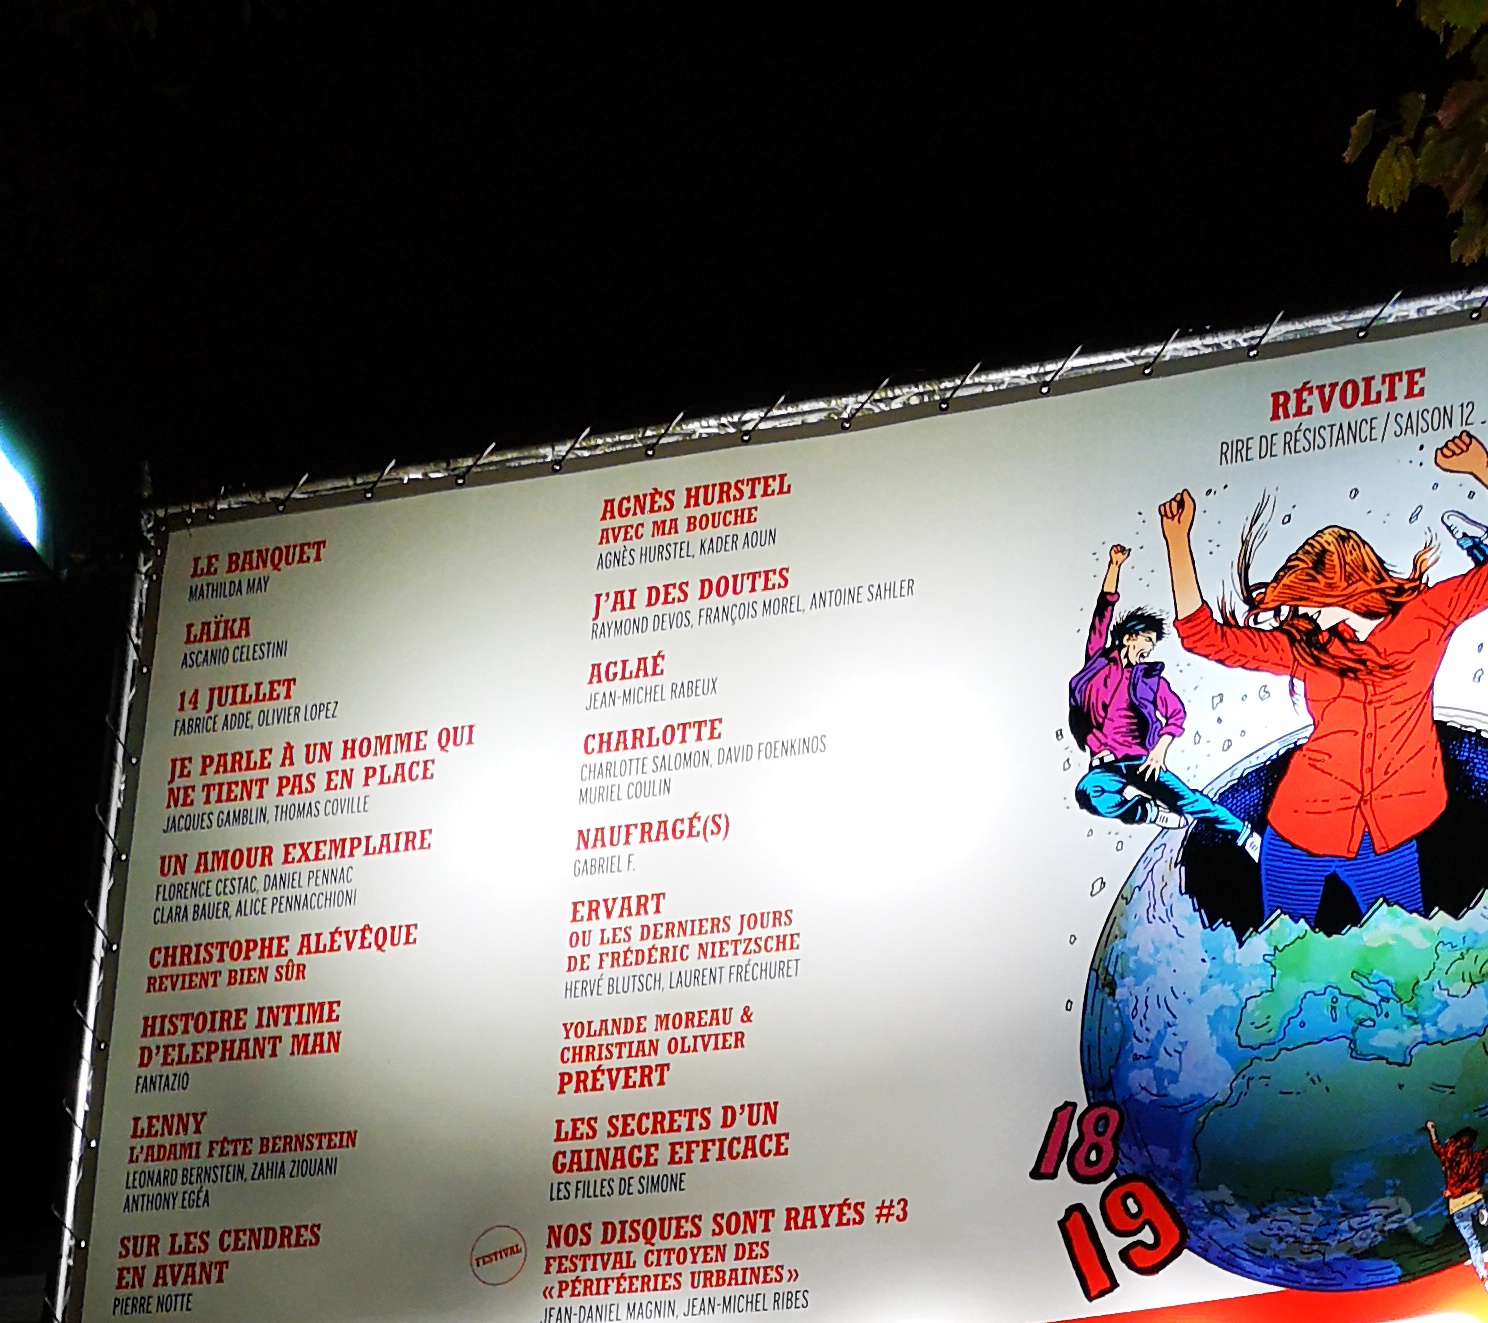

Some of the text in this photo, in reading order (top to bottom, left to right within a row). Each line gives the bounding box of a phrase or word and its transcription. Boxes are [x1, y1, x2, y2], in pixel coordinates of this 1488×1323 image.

[1270, 367, 1425, 421] RÉVOLTE
[1220, 437, 1254, 465] RIRE
[1259, 433, 1278, 459] DE
[1283, 417, 1378, 455] RÉSISTANCE
[1394, 405, 1453, 437] SAISON
[1461, 401, 1474, 431] 12
[601, 474, 791, 521] AGNÈS HURSTEL
[598, 506, 758, 545] AVEC MA BOUCHE
[190, 540, 326, 579] LE BANQUET
[188, 576, 269, 602] MATHILDA MAY
[592, 567, 789, 620] J'AI DES DOUTES
[184, 615, 250, 645] LAÏKA
[589, 650, 665, 684] AGLAÉ
[178, 678, 296, 714] 14 JUILLET
[168, 725, 474, 785] JE PARLE À UN HOMME QUI
[584, 718, 722, 755] CHARLOTTE
[165, 760, 434, 809] NE TIENT PAS EN PLACE
[576, 812, 729, 850] NAUFRAGÉ(S)
[160, 829, 432, 877] UN AMOUR EXEMPLAIRE
[571, 893, 665, 922] ERVART
[149, 924, 417, 969] CHRISTOPHE ALÉVÊQUE
[569, 909, 792, 948] OU LES DERNIERS JOURS
[567, 933, 800, 972] DE FRÉDÉRIC NIETZSCHE
[146, 959, 306, 993] REVIENT BIEN SÛR
[141, 1000, 340, 1037] HISTOIRE INTIME
[563, 1006, 753, 1039] YOLANDE MOREAU &
[138, 1031, 341, 1068] D'ELEPHANT MAN
[560, 1031, 744, 1064] CHRISTIAN OLIVIER
[135, 1071, 189, 1093] FANTAZIO
[558, 1063, 670, 1094] PRÉVERT
[130, 1111, 207, 1139] LENNY
[554, 1101, 778, 1142] LES SECRETS D'UN
[128, 1130, 357, 1164] L'ADAMI FÊTE BERNSTEIN
[552, 1133, 789, 1174] GAINAGE EFFICACE
[1030, 1100, 1124, 1185] 18
[550, 1172, 686, 1201] LES FILLES DE SIMONE
[119, 1224, 321, 1259] SUR LES CENDRES
[546, 1198, 908, 1249] NOS DISQUES SONT RAYÉS #3
[1057, 1173, 1188, 1302] 19
[475, 1243, 522, 1269] FESTIVAL
[544, 1241, 769, 1275] FESTIVAL CITOYEN DES
[115, 1262, 229, 1290] EN AVANT
